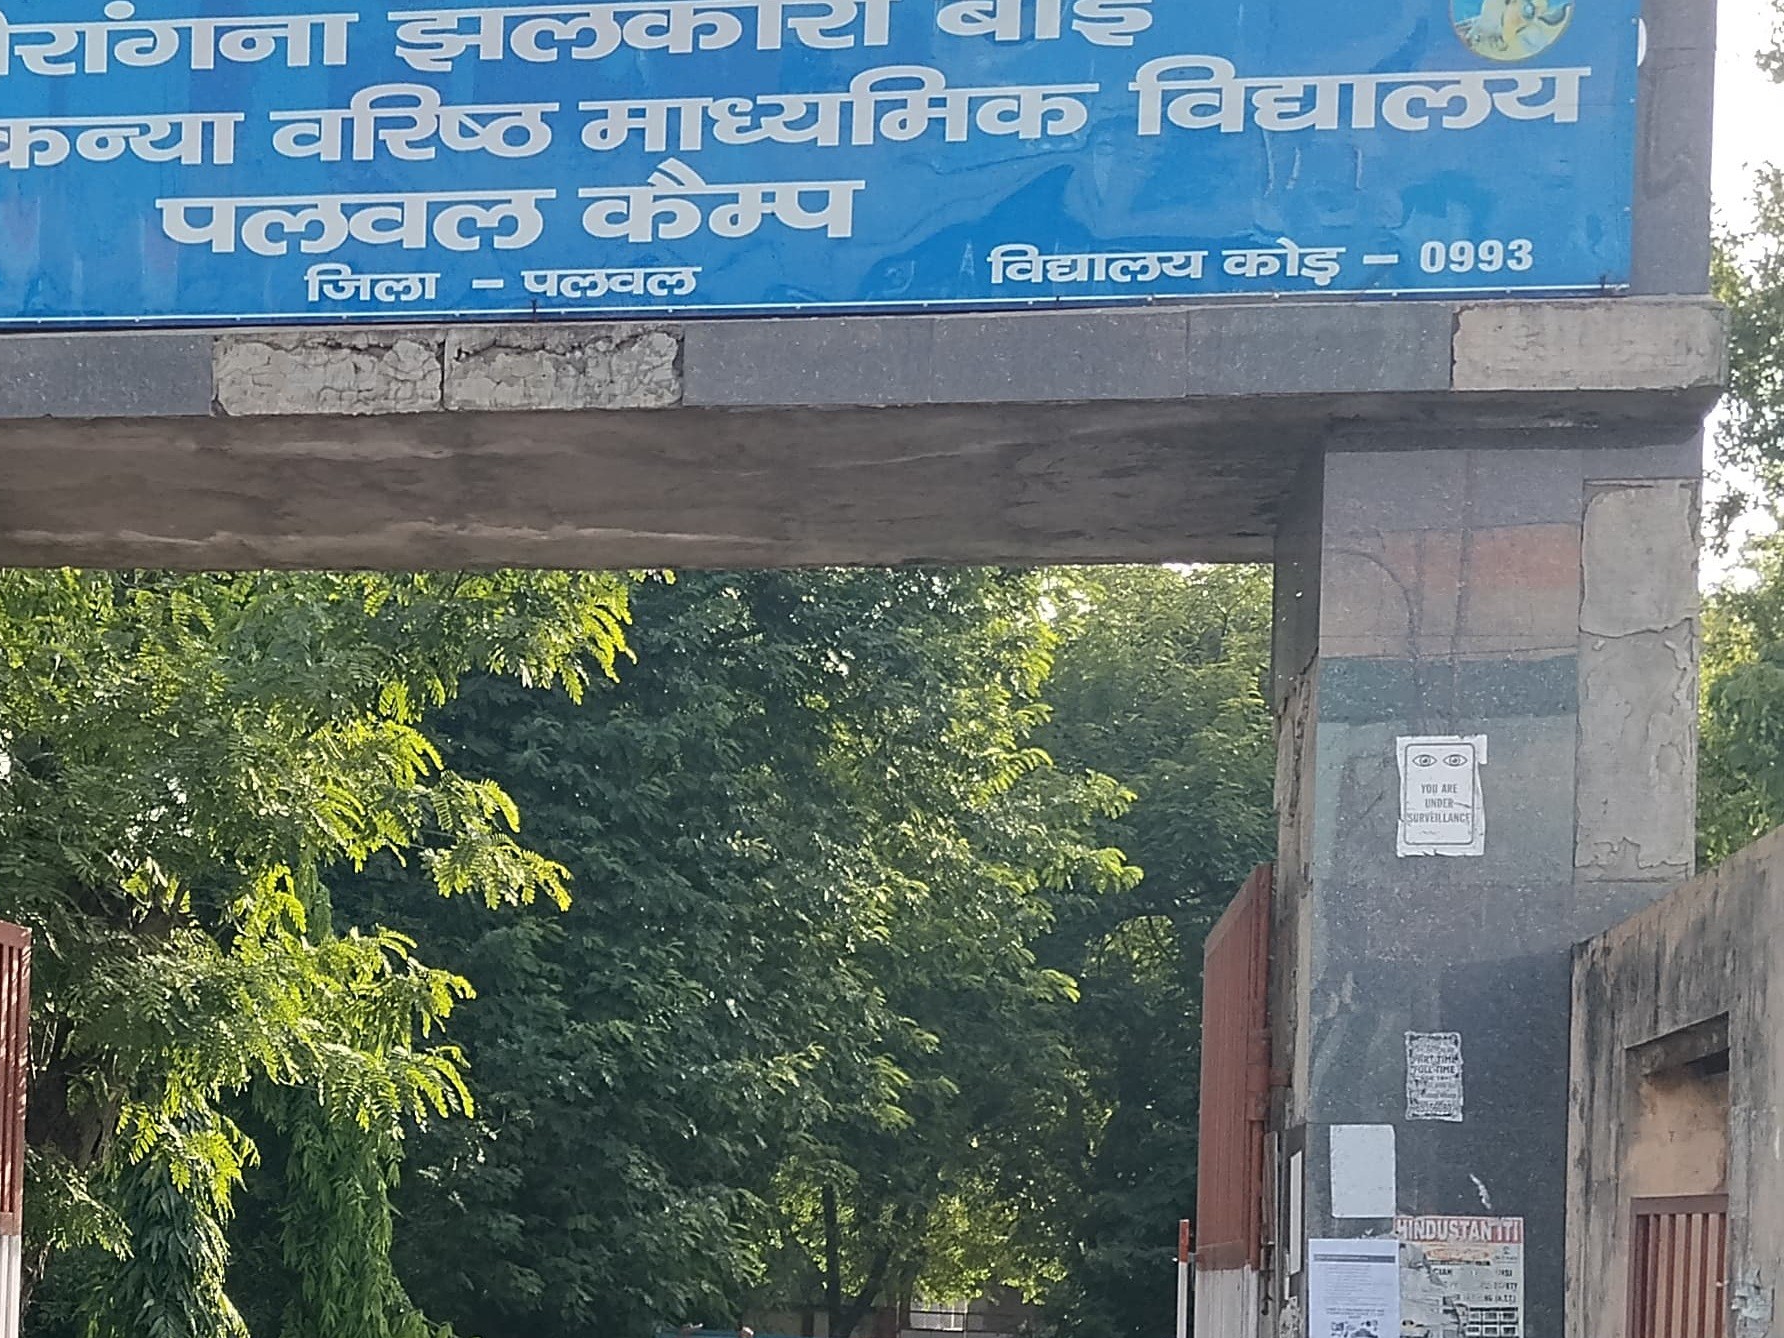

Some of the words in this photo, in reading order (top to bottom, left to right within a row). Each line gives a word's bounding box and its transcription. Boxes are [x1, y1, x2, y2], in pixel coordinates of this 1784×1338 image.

[269, 83, 560, 162] वरिष्ठ
[581, 66, 1100, 153] माध्यमिक
[1130, 55, 1592, 136] विद्यालय
[156, 189, 557, 256] पलवल
[580, 160, 865, 243] कैम्प
[987, 244, 1208, 284] विद्यालय
[1420, 239, 1534, 273] 0993
[305, 263, 438, 303] जिला
[522, 265, 702, 298] पलवल
[1421, 784, 1438, 793] YOU
[1442, 784, 1457, 793] ARE
[1425, 798, 1454, 808] UNDER
[1407, 813, 1471, 822] SURVEILLANCE
[1396, 1219, 1492, 1241] HINDUSTAN
[1497, 1219, 1522, 1241] ITI
